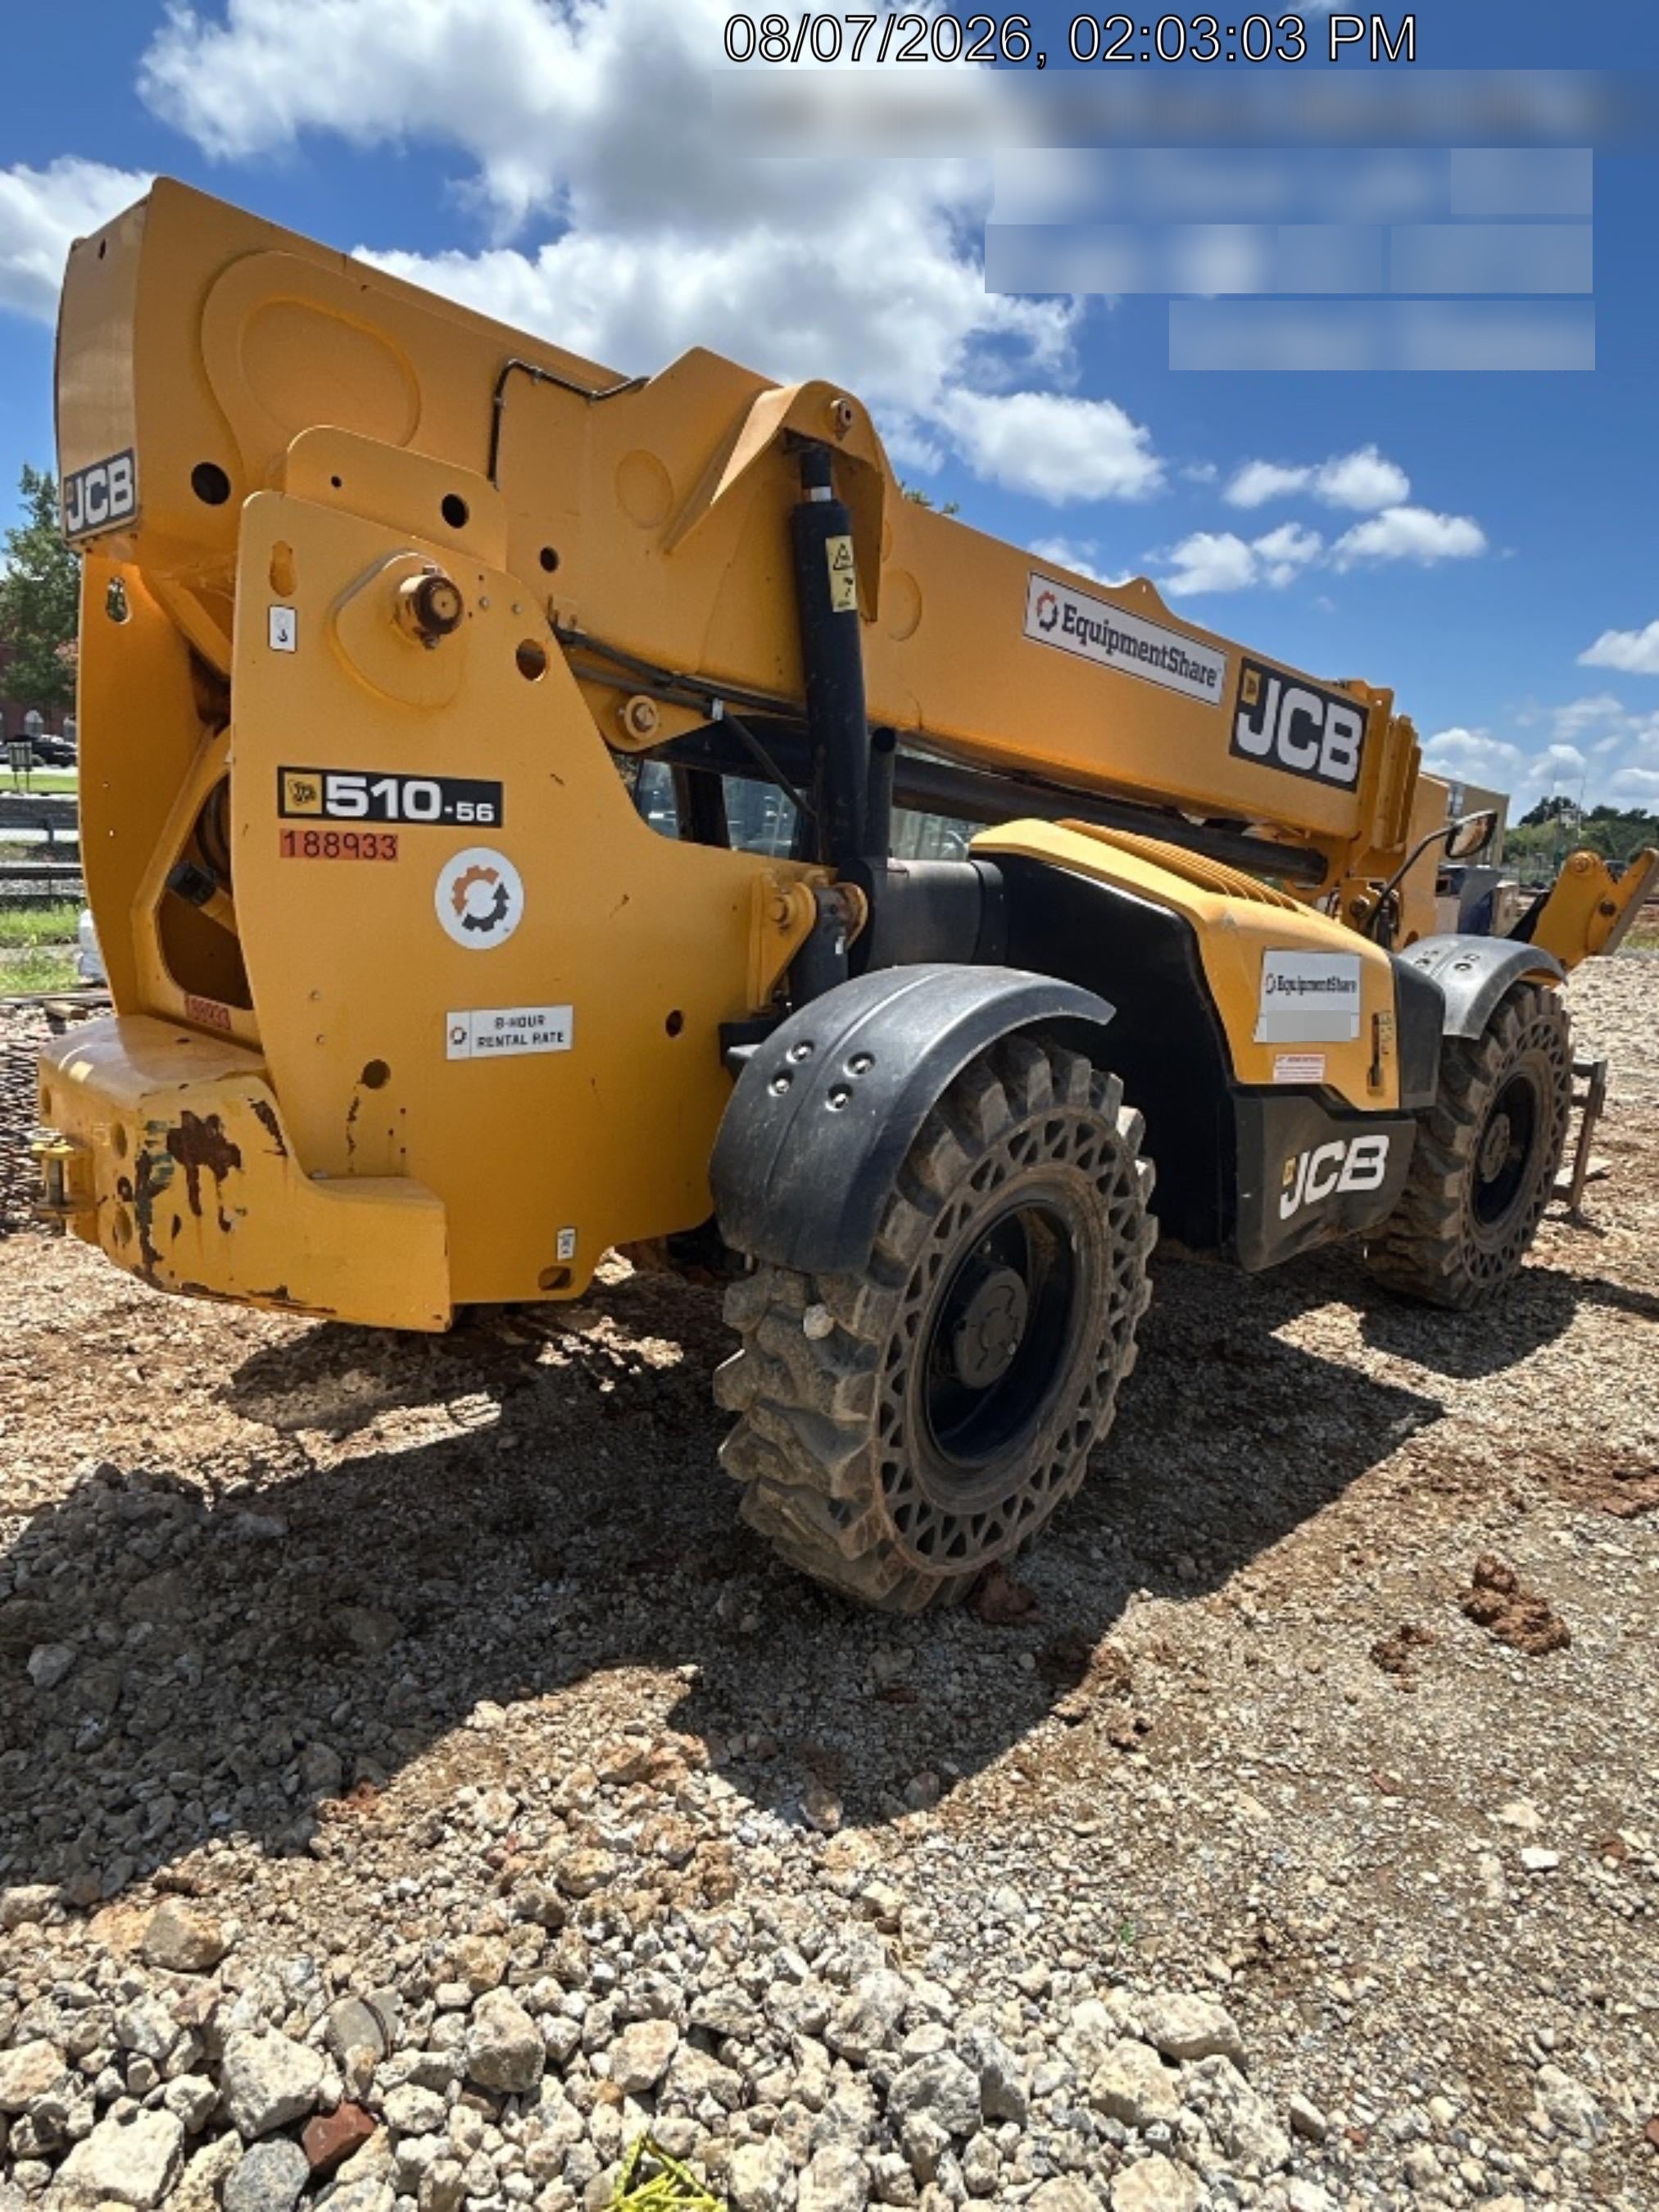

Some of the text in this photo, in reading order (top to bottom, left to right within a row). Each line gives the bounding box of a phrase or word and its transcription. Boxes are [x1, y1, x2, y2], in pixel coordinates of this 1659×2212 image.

[67, 456, 133, 532] JCB
[1062, 604, 1217, 688] EquipmentShare
[1235, 678, 1363, 783] JCB
[326, 776, 495, 823] 510-56
[283, 830, 398, 860] 188933
[478, 1031, 564, 1048] RENTAL RATE
[1280, 1135, 1390, 1220] JCB
